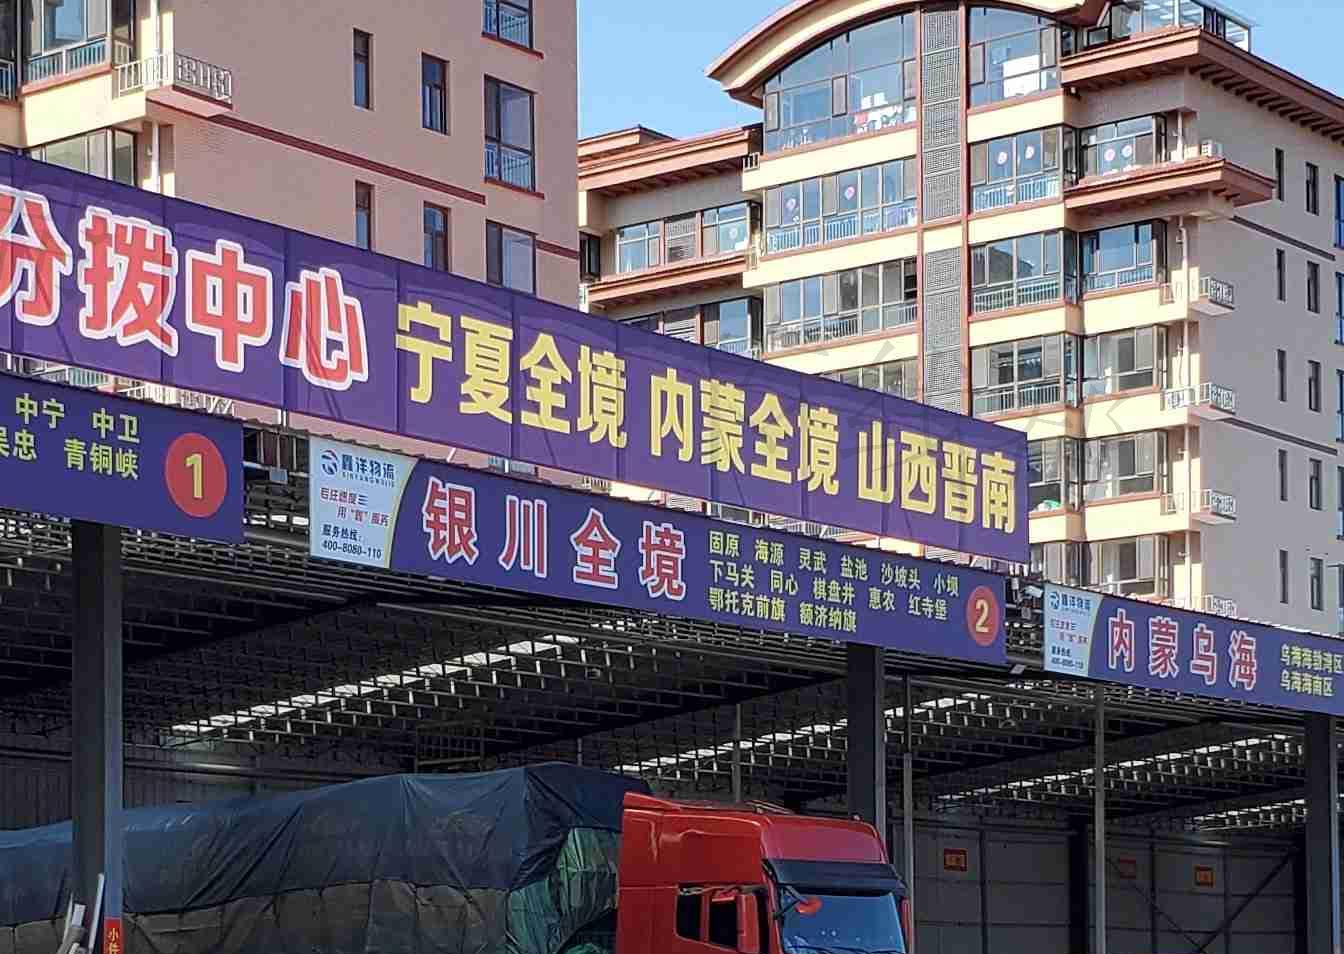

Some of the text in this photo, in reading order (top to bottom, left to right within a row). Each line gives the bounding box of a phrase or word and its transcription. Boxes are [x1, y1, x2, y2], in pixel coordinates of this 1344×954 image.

[15, 392, 65, 429] 中宁
[92, 407, 141, 444] 中卫
[396, 301, 627, 448] 宁夏全境
[650, 367, 840, 496] 内蒙全境
[857, 421, 1018, 535] 山西晋南
[64, 437, 139, 480] 青铜峡
[185, 453, 204, 500] 1
[421, 474, 687, 602] 银川全境
[709, 531, 740, 559] 固原
[799, 547, 828, 575] 灵武
[840, 555, 869, 582] 盐池
[881, 563, 921, 590] 沙坡头
[709, 559, 756, 590] 下马关
[770, 569, 799, 597] 同心
[974, 599, 990, 634] 2
[1107, 607, 1258, 690] 内蒙乌海
